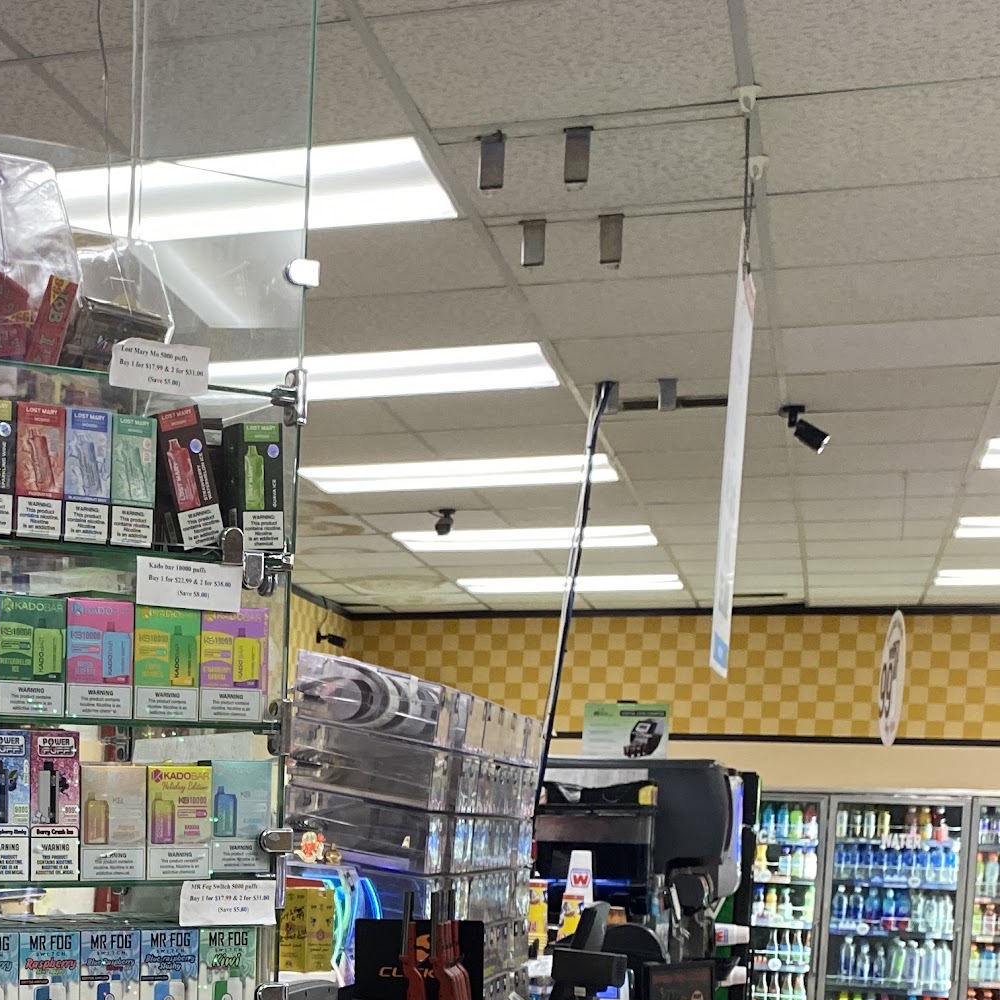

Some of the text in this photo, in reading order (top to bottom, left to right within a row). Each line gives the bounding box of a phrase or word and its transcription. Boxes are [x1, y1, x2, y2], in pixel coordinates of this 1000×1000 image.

[134, 347, 149, 356] Mary
[164, 379, 180, 387] $5.00)
[163, 771, 210, 781] KADOBAR
[162, 781, 209, 792] Holiday Edition
[881, 833, 921, 849] WATER
[214, 953, 241, 968] Kiwi
